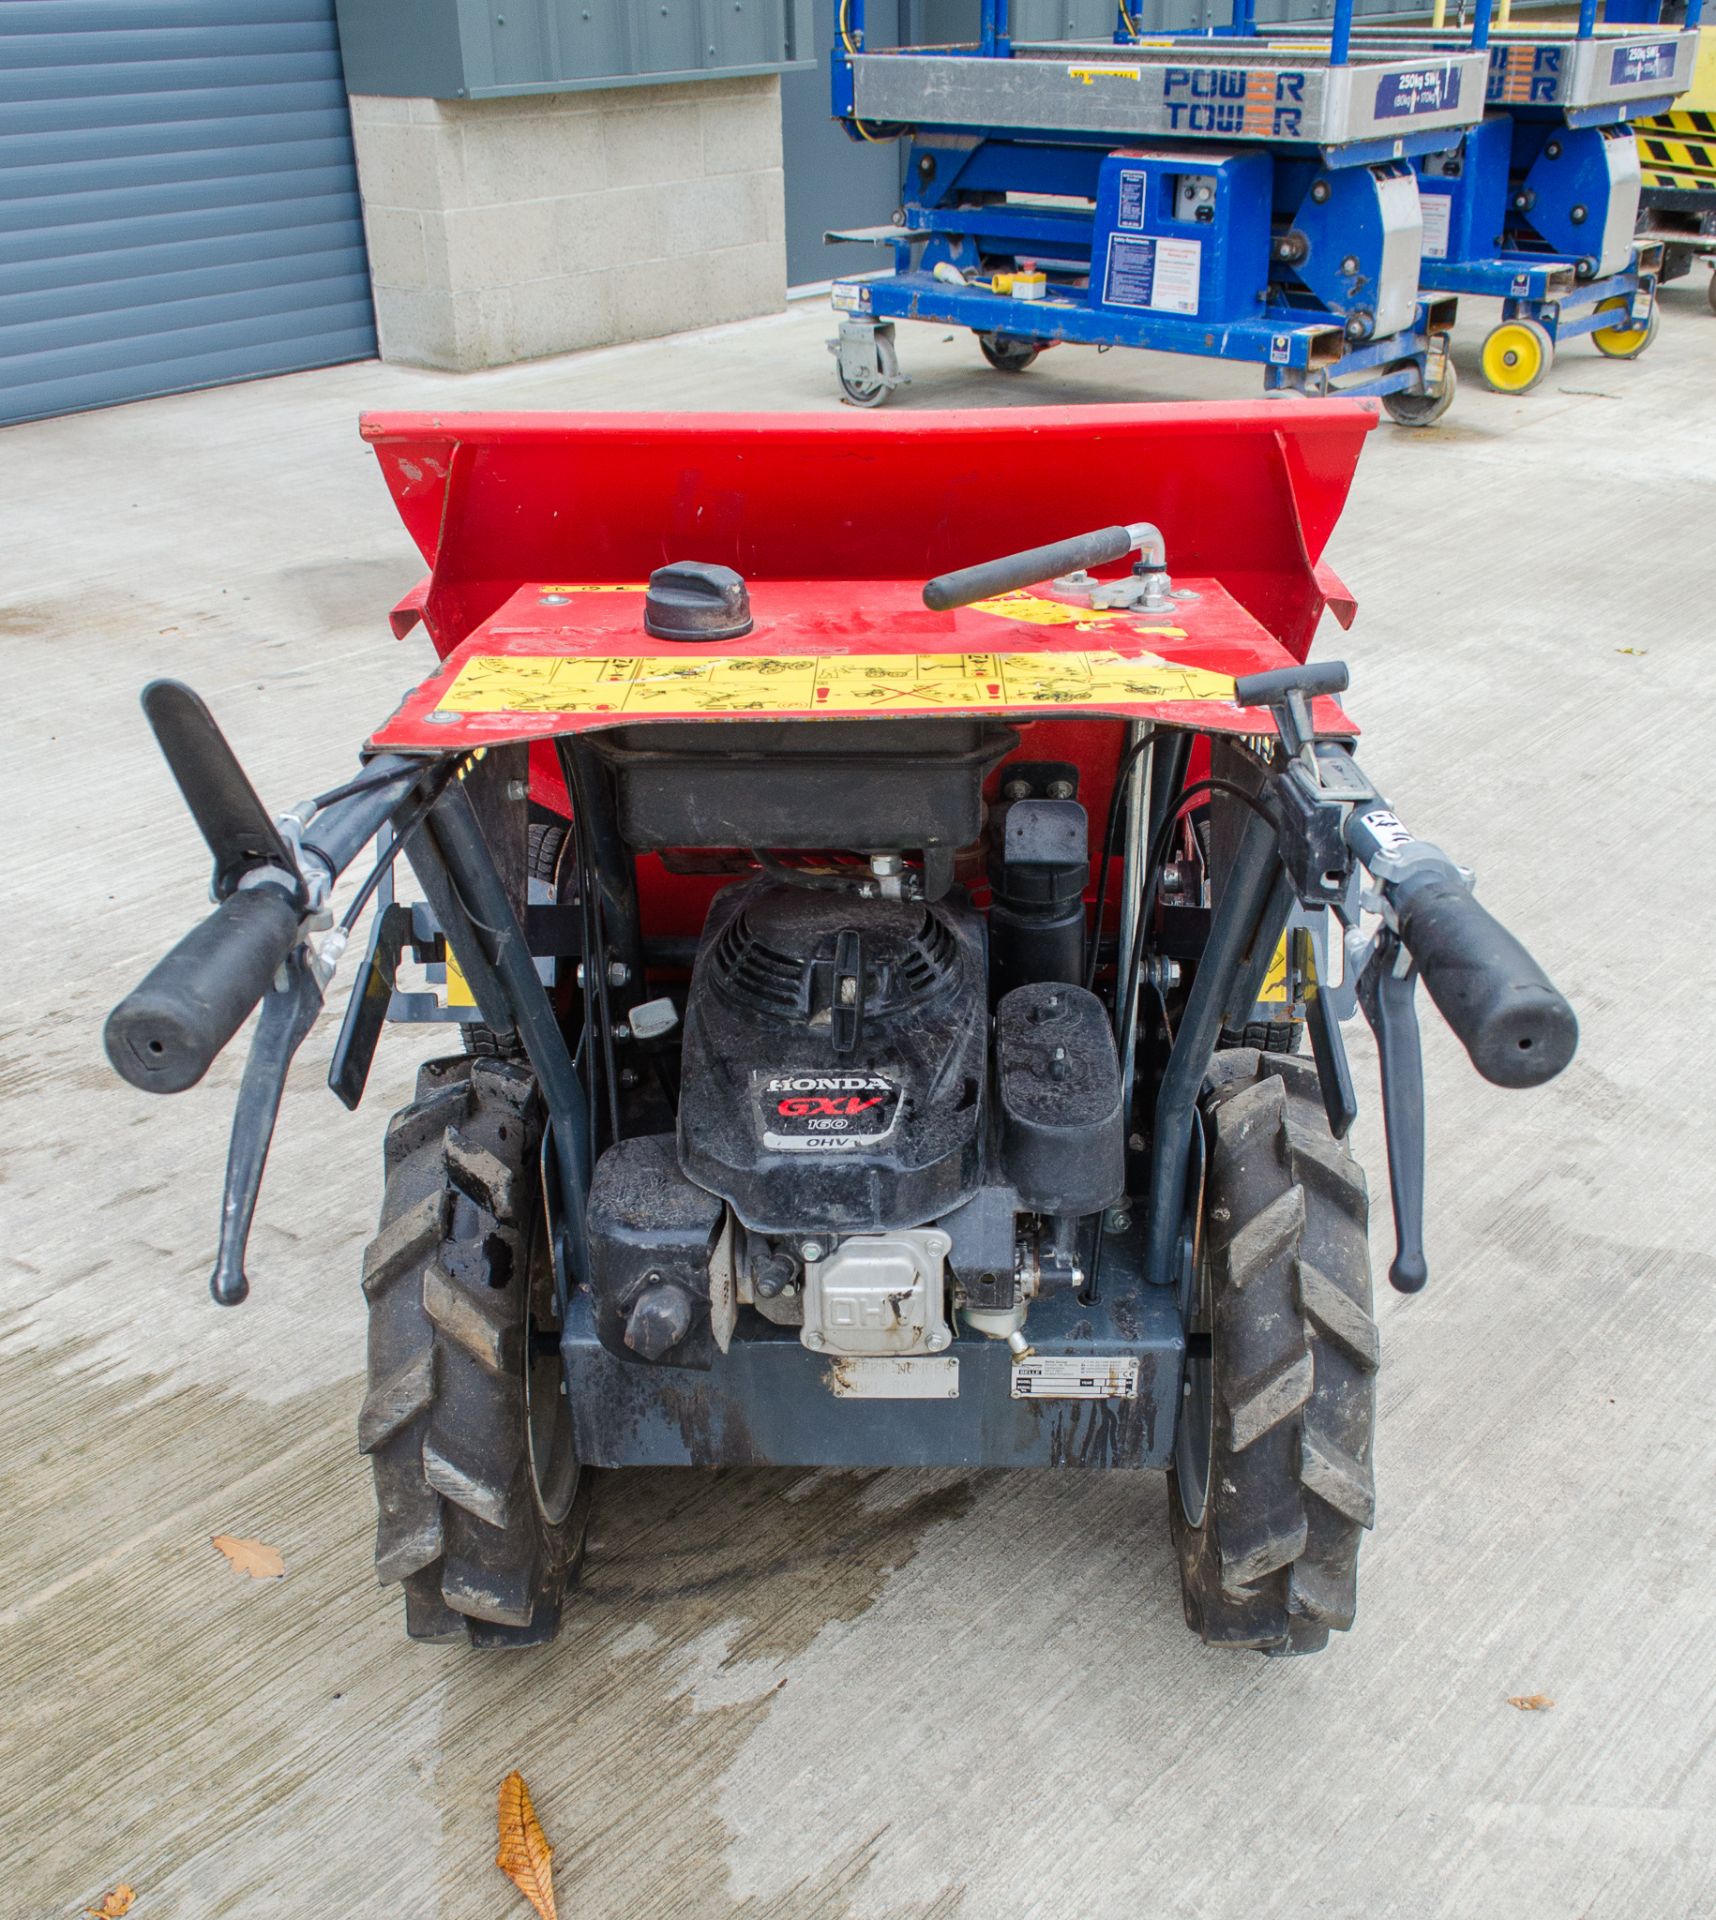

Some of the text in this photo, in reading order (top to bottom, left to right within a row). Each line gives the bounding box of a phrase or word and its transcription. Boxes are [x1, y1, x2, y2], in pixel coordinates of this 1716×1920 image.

[1163, 68, 1304, 102] POWER
[1398, 71, 1440, 90] 250kg SWL
[1162, 102, 1302, 136] TOWER
[766, 1078, 892, 1092] HONDA
[778, 1097, 883, 1116] GXV
[808, 1119, 848, 1130] 160
[806, 1138, 849, 1147] OHV
[831, 1297, 918, 1326] OHV
